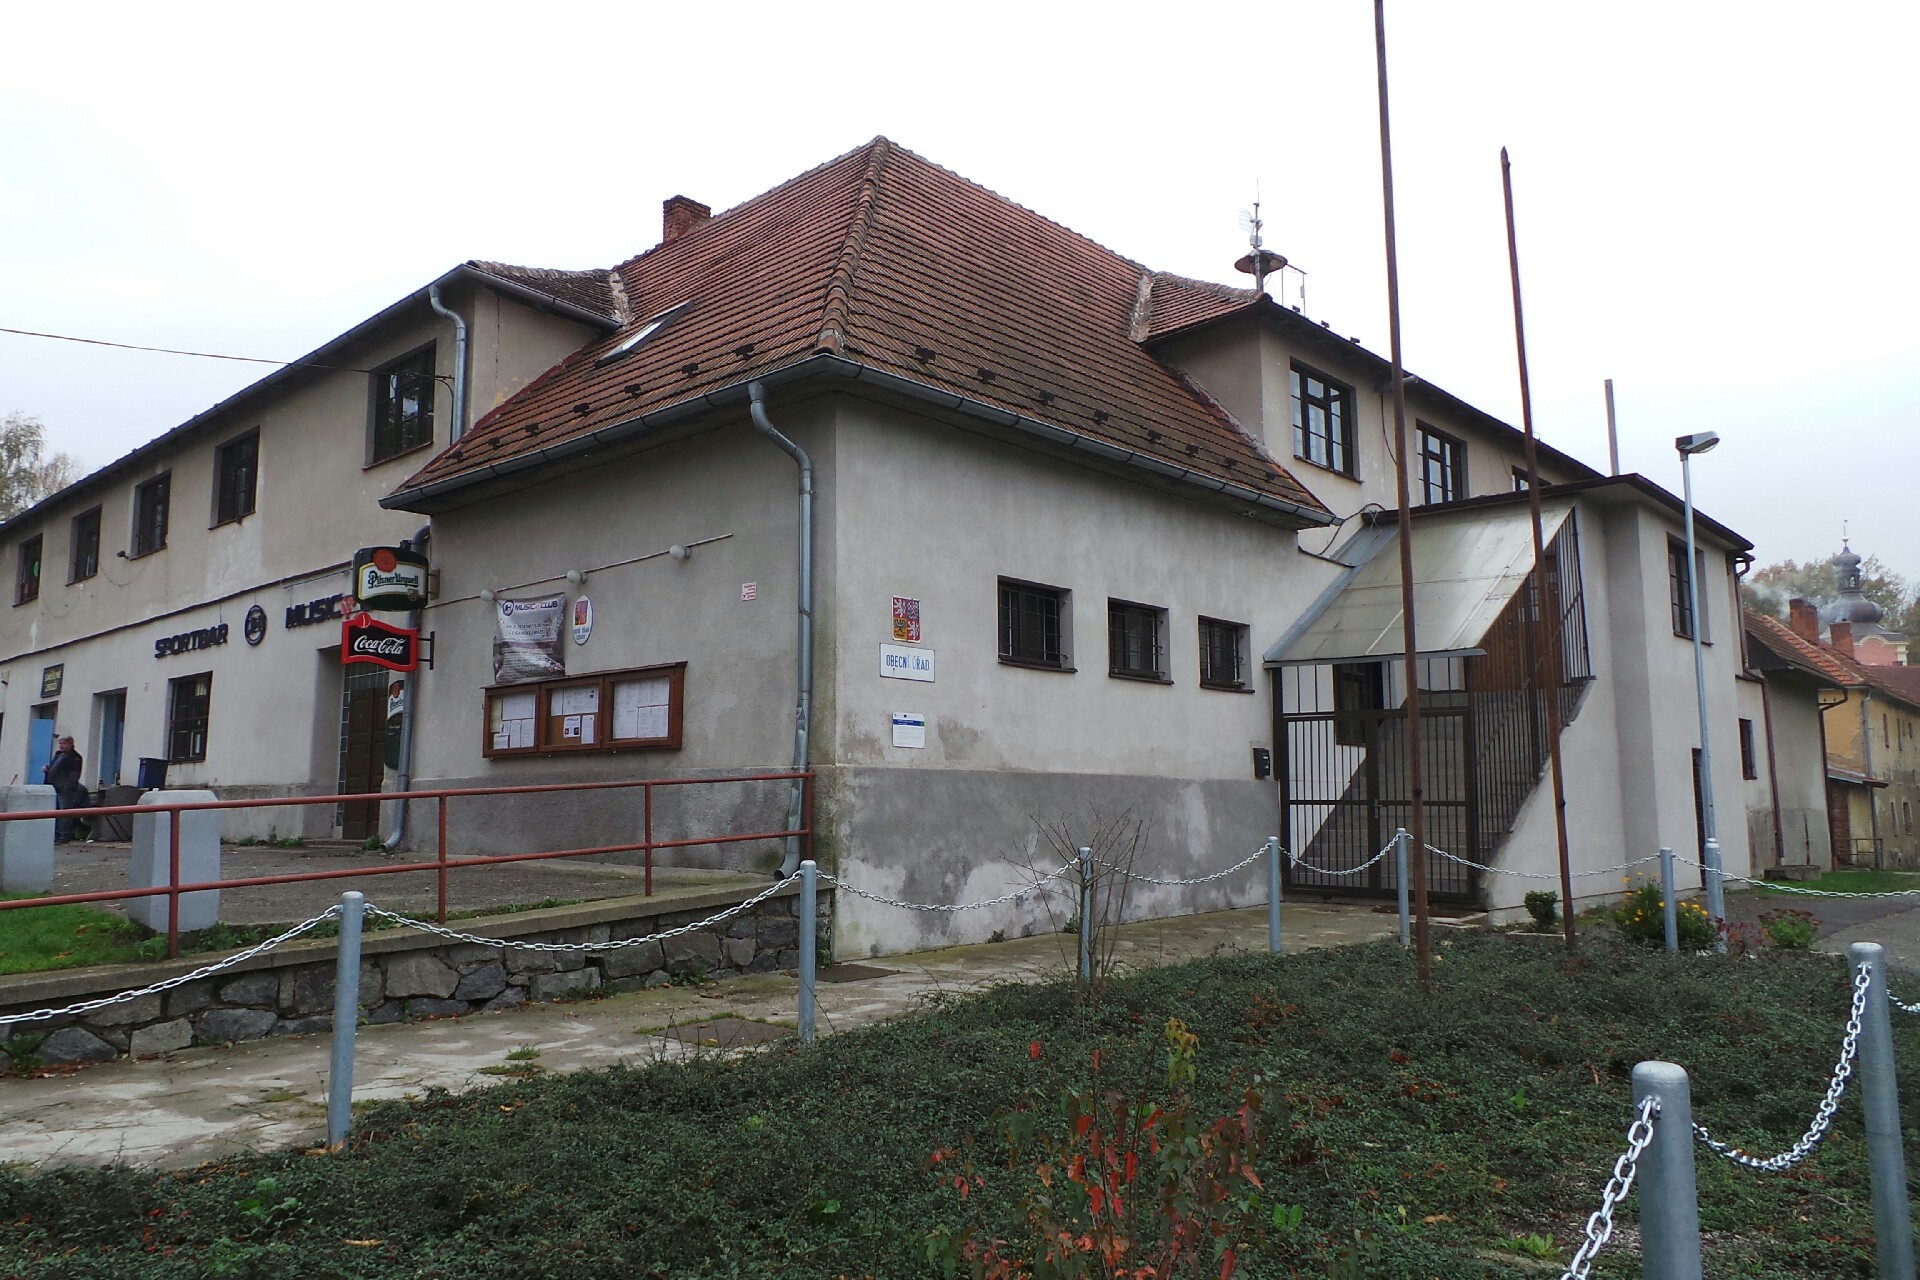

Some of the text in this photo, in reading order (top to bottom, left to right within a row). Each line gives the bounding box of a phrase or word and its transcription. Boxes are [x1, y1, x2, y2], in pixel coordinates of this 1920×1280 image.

[367, 570, 419, 589] Pilsner Urquell
[285, 593, 343, 629] MUSIC
[514, 603, 535, 611] MUSIC
[540, 601, 558, 609] CLUB
[154, 623, 228, 659] SPORTBAR
[886, 654, 930, 671] OBECNÍ ÚŘAD
